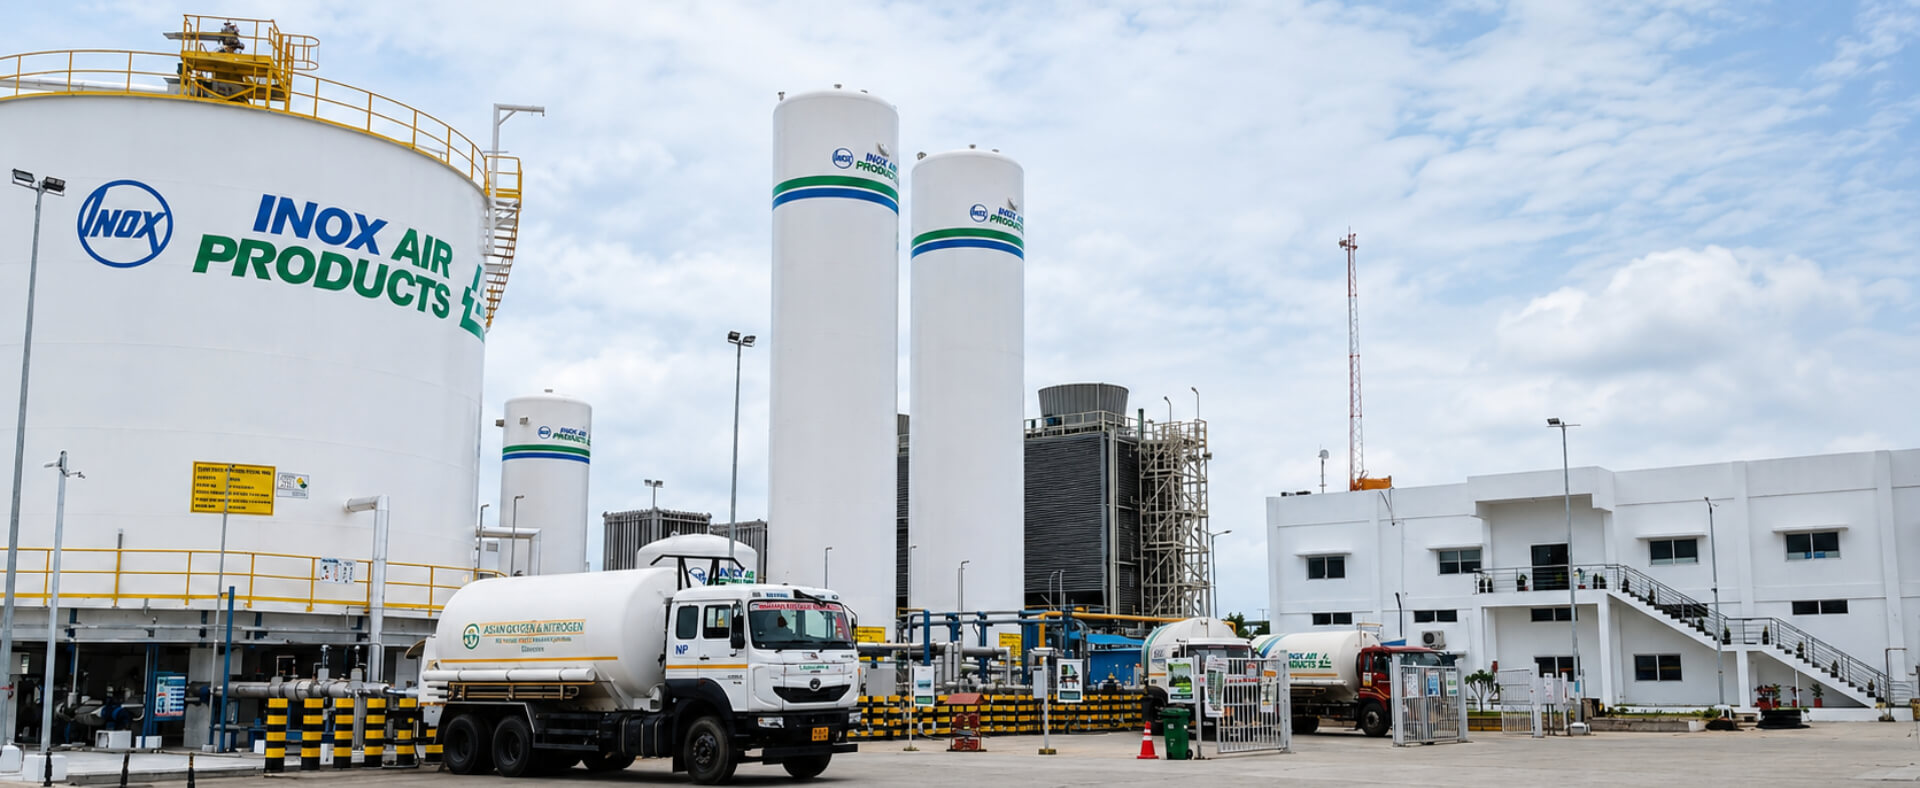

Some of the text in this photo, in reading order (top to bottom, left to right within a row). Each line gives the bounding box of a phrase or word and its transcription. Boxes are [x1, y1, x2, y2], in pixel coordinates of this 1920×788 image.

[77, 184, 170, 256] INOX
[252, 194, 453, 279] INOX AIR
[192, 234, 451, 319] PRODUCTS
[543, 621, 584, 632] NITROGEN
[675, 645, 689, 655] NP
